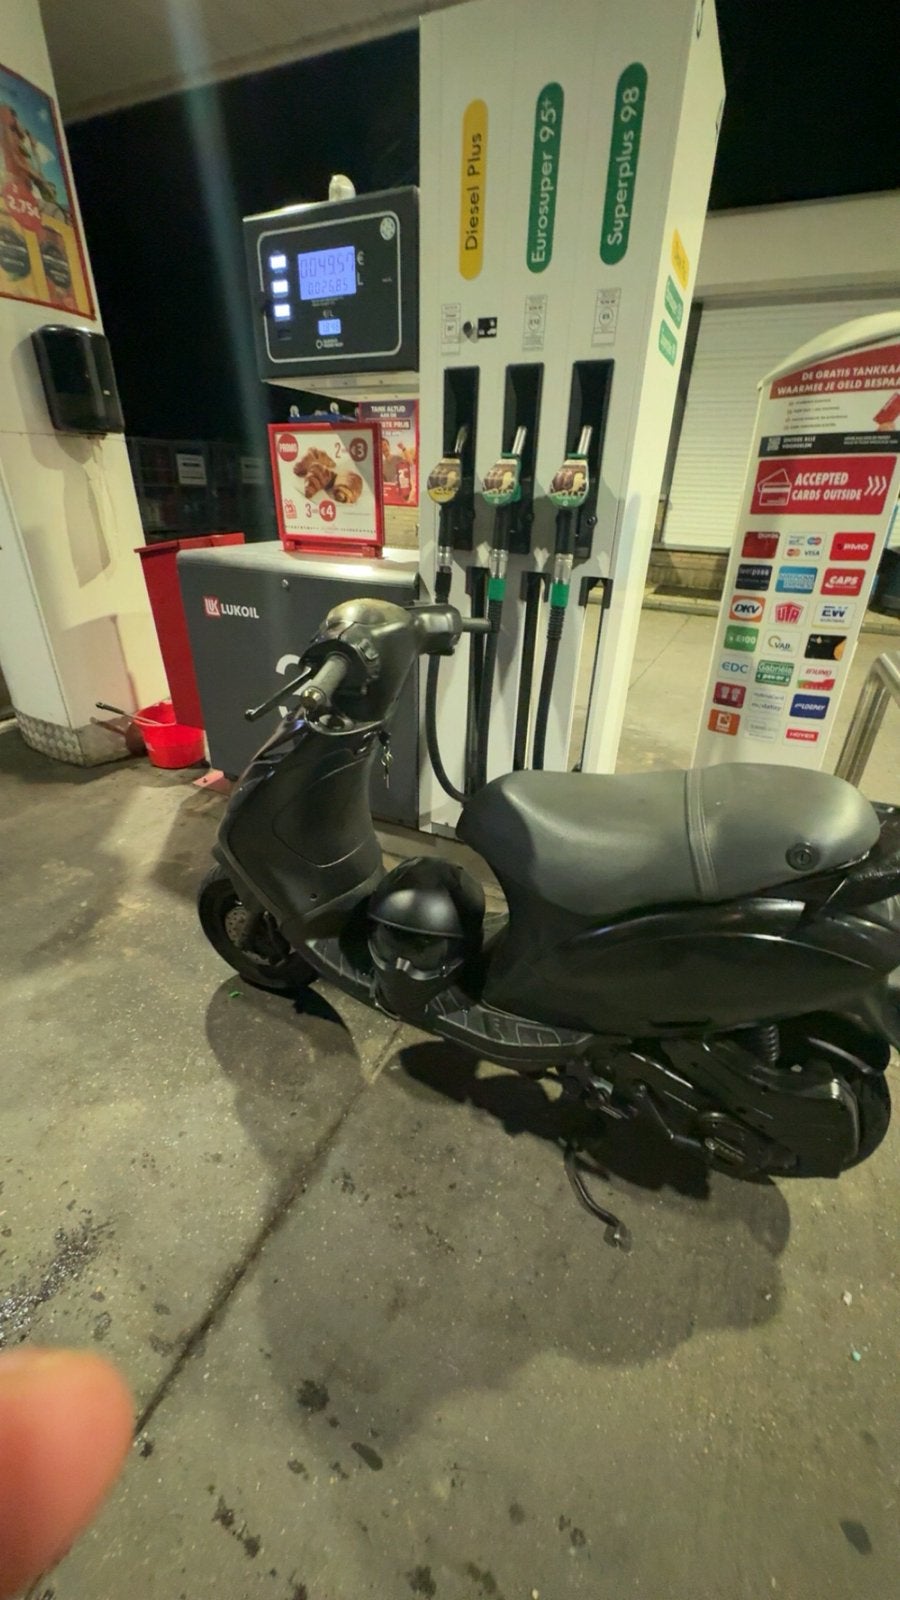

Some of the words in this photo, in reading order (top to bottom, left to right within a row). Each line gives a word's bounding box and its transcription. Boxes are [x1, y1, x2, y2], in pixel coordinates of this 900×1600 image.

[620, 86, 640, 122] 98
[467, 133, 482, 177] Plus
[607, 130, 634, 245] Superplus
[531, 152, 553, 263] Eurosuper
[465, 185, 480, 250] Diesel
[802, 372, 813, 381] DE
[815, 368, 850, 379] GRATIS
[777, 383, 822, 394] WAARMEE
[825, 381, 834, 391] JE
[837, 379, 862, 390] GELD
[371, 405, 385, 413] TANK
[334, 442, 342, 459] 2
[351, 441, 364, 459] €3
[794, 472, 849, 486] ACCEPTED
[792, 489, 820, 501] CARDS
[823, 489, 862, 501] OUTSIDE
[305, 503, 312, 518] 3
[320, 505, 334, 518] €4
[829, 575, 859, 586] CAPS
[220, 602, 260, 619] LUKOIL
[734, 603, 760, 615] DKV
[775, 606, 801, 624] UTA
[721, 661, 749, 674] EDC
